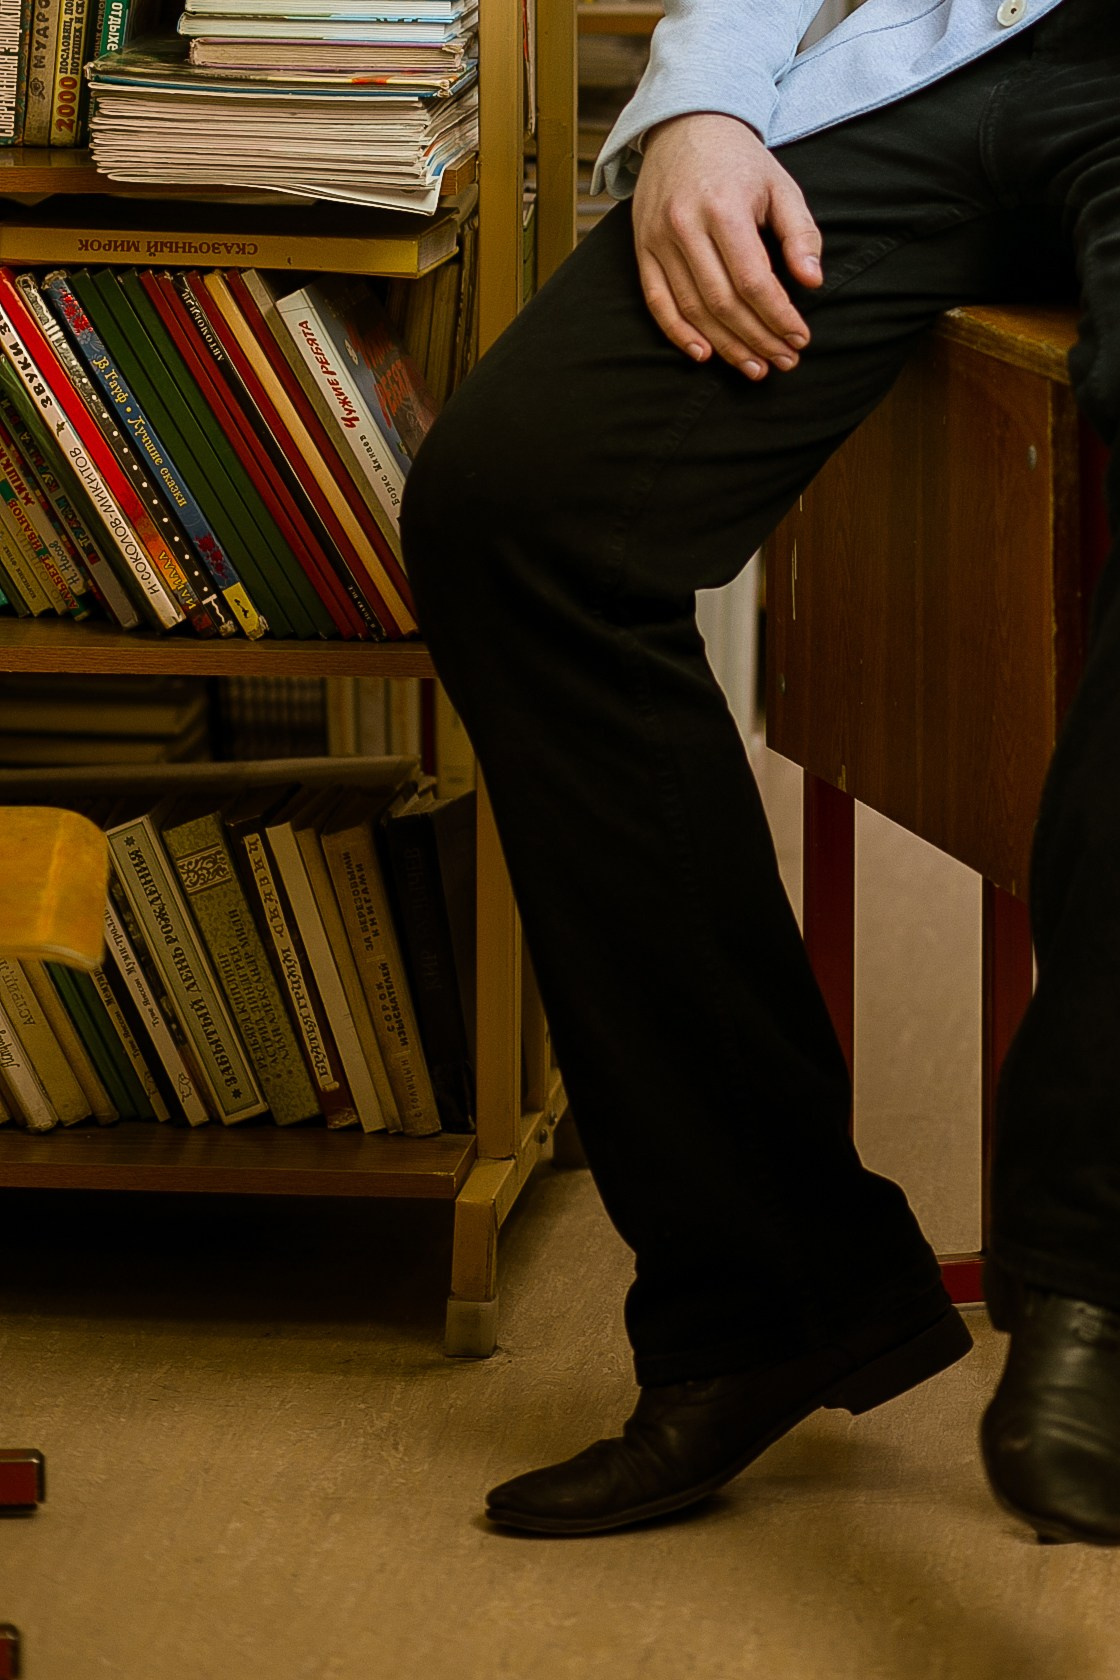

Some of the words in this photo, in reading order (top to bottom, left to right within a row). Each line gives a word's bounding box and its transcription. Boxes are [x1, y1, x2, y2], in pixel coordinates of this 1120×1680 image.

[106, 2, 123, 52] отдыхе
[0, 56, 18, 138] СОВРЕМЕННАЯ
[56, 76, 77, 133] 2000
[78, 239, 140, 252] МИРОК
[146, 241, 258, 257] СКАЗОЧНЫЙ
[9, 342, 53, 408] ЗВУКИ
[93, 356, 109, 372] В.
[104, 369, 129, 403] Гауф
[128, 415, 163, 466] Лучшие
[160, 465, 187, 508] сказки
[359, 434, 382, 473] Минаев
[381, 475, 400, 507] Борис
[8, 500, 42, 551] ИВАНОВ
[40, 554, 79, 609] АЛЬБЕРТ
[128, 847, 178, 945] РОЖДЕНИЯ
[172, 946, 201, 994] ДЕНЬ
[190, 997, 239, 1087] ЗАБЫТЫЙ
